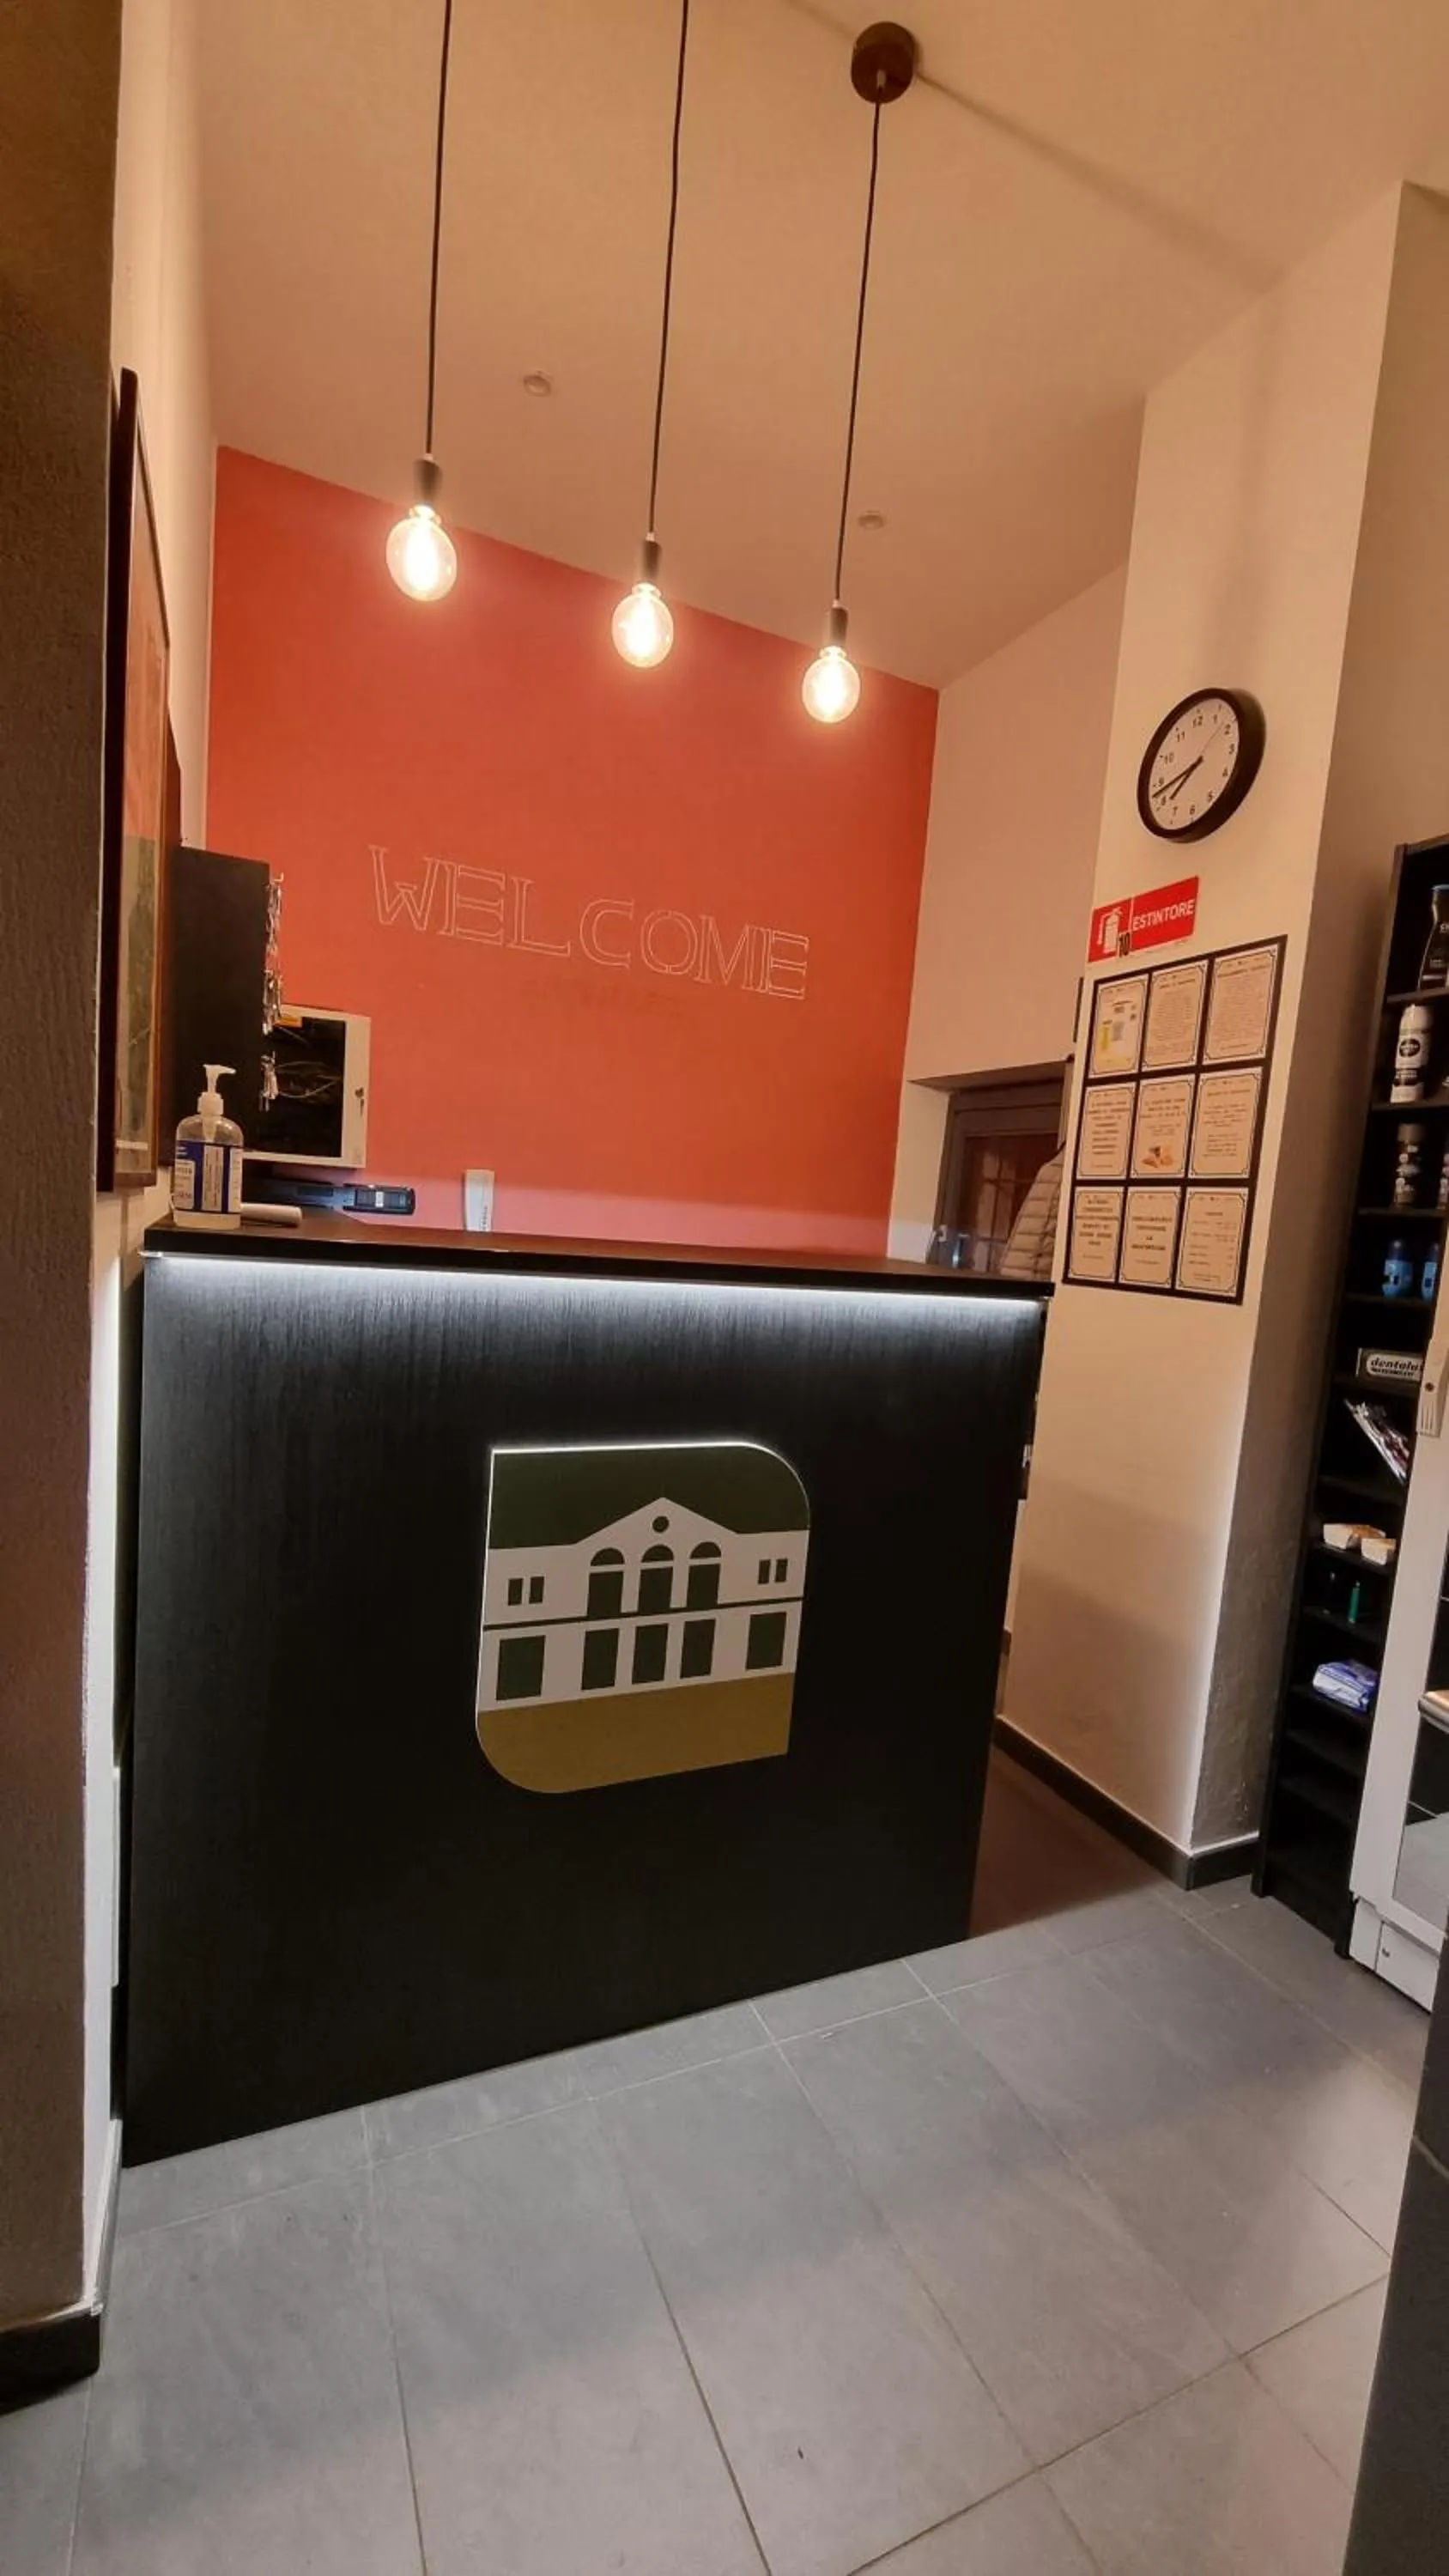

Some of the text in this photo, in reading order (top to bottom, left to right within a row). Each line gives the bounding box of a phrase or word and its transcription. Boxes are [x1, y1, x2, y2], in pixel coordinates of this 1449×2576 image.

[1192, 715, 1203, 728] 12
[1224, 724, 1231, 735] 2
[1177, 731, 1185, 742] 11
[1228, 744, 1234, 755] 3
[1164, 752, 1174, 764] 10
[1222, 767, 1228, 777] 4
[1207, 790, 1214, 803] 5
[1190, 805, 1196, 815] 6
[1132, 899, 1195, 931] ESTINTORE
[368, 844, 809, 999] WELCOME
